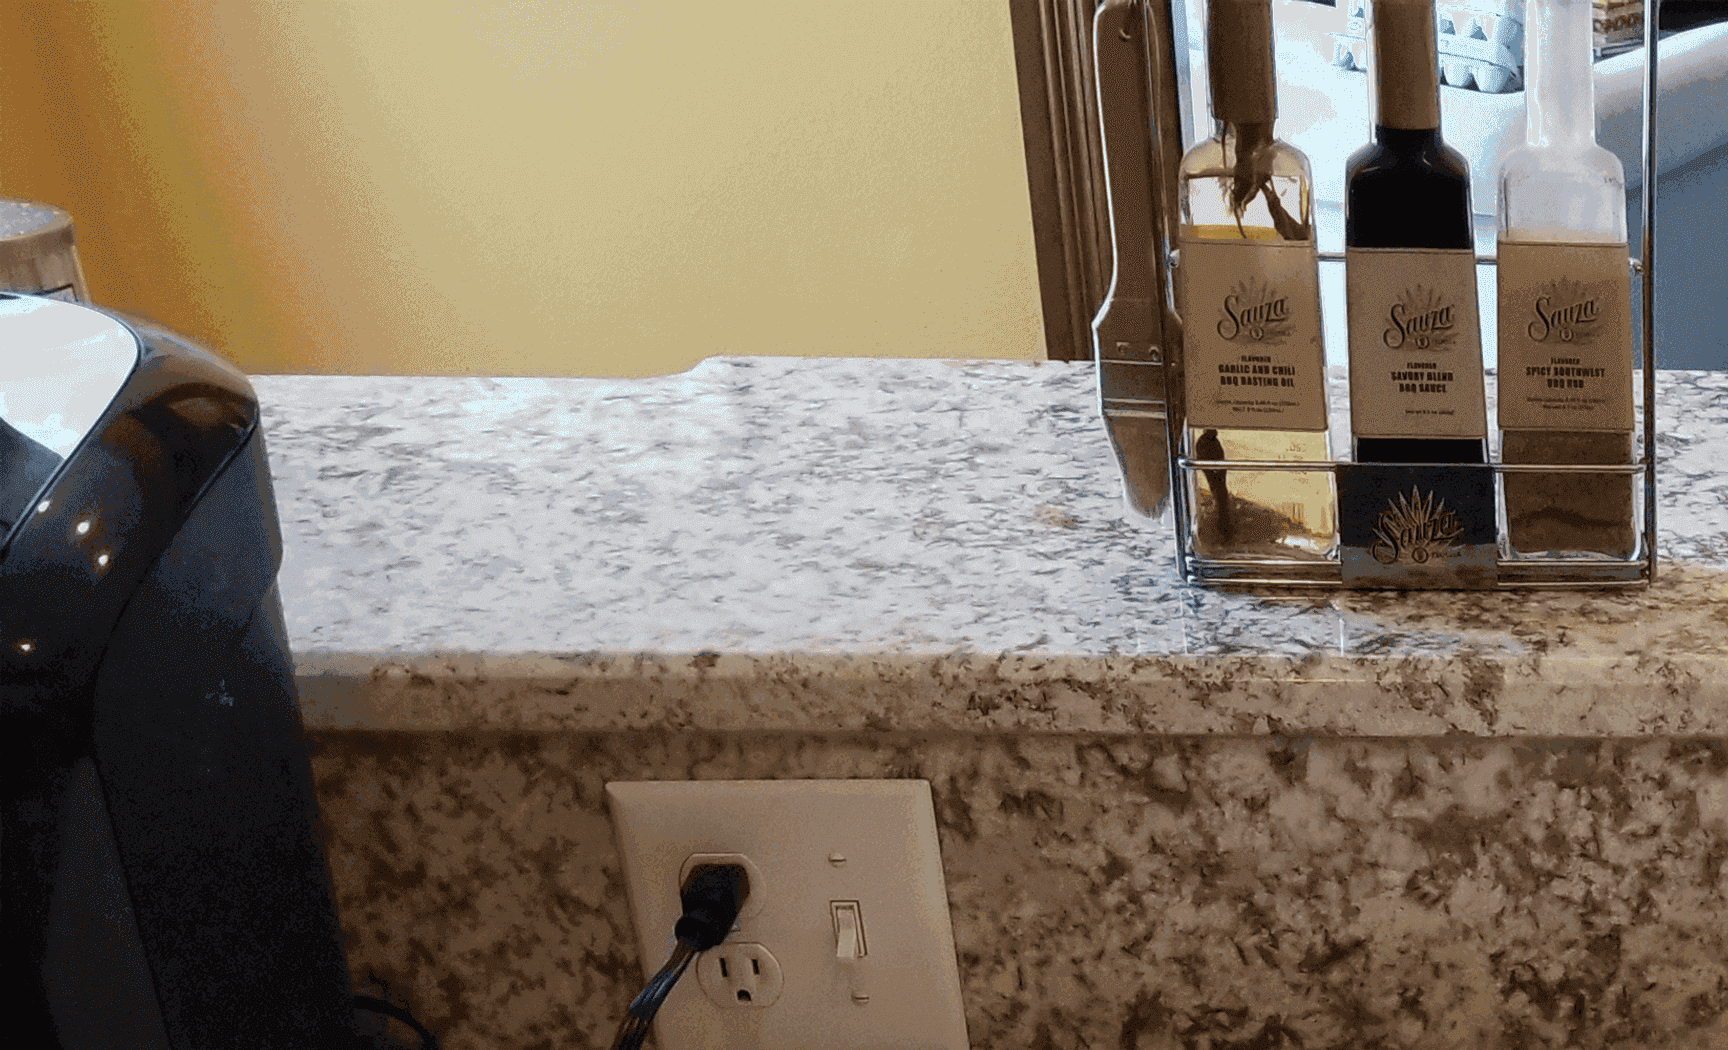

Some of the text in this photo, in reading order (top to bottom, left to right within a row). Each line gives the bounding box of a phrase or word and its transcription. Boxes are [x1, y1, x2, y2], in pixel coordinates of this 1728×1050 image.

[1217, 295, 1289, 340] Sauza
[1528, 296, 1599, 342] Sauza
[1383, 303, 1455, 349] Sauza
[1218, 364, 1295, 375] GARLIC AND CHILI
[1526, 366, 1605, 377] SPICY SOUTHWEST
[1220, 376, 1294, 387] BBQ BASTING OIL
[1391, 371, 1424, 381] SAVORY
[1399, 383, 1446, 393] BBQ SAUCE
[1547, 379, 1584, 389] BBQ RUB
[1372, 510, 1464, 565] Sauza
